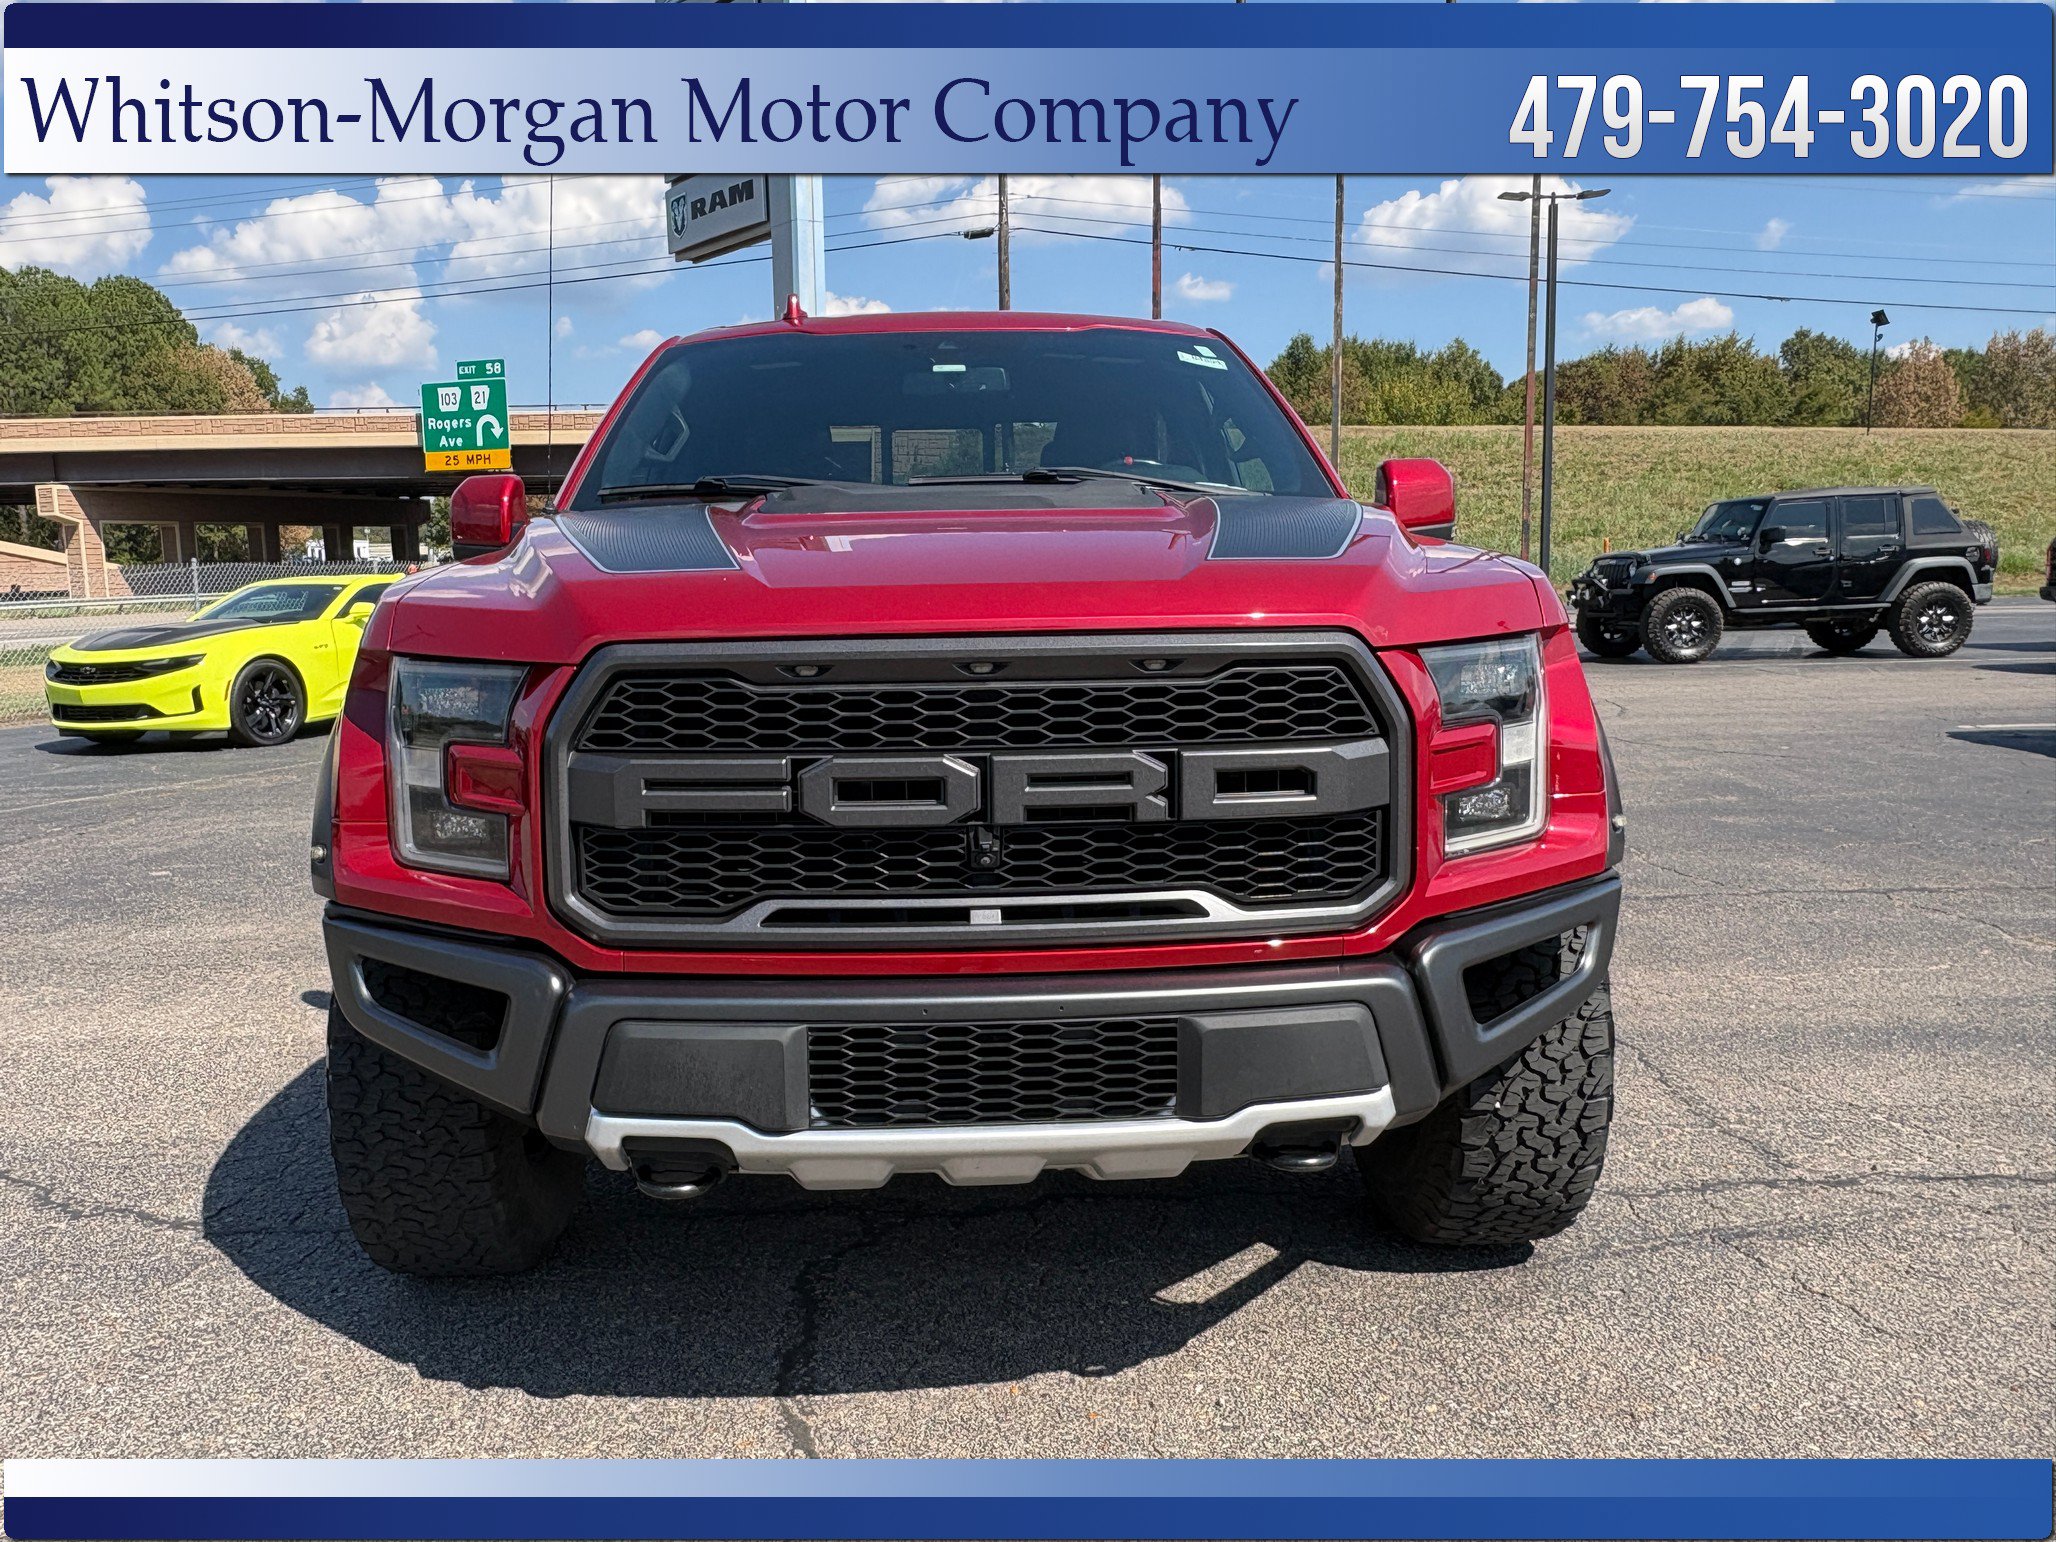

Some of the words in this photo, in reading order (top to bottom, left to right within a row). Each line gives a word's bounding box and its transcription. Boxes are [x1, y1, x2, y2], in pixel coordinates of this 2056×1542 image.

[690, 178, 754, 221] RAM
[458, 365, 477, 375] EXIT
[485, 362, 502, 375] 58
[440, 392, 458, 406] 103
[473, 391, 487, 405] 21
[427, 417, 472, 433] Rogers
[439, 435, 464, 448] Ave
[444, 454, 460, 466] 25
[466, 453, 492, 465] MPH
[575, 742, 1386, 827] FORD
